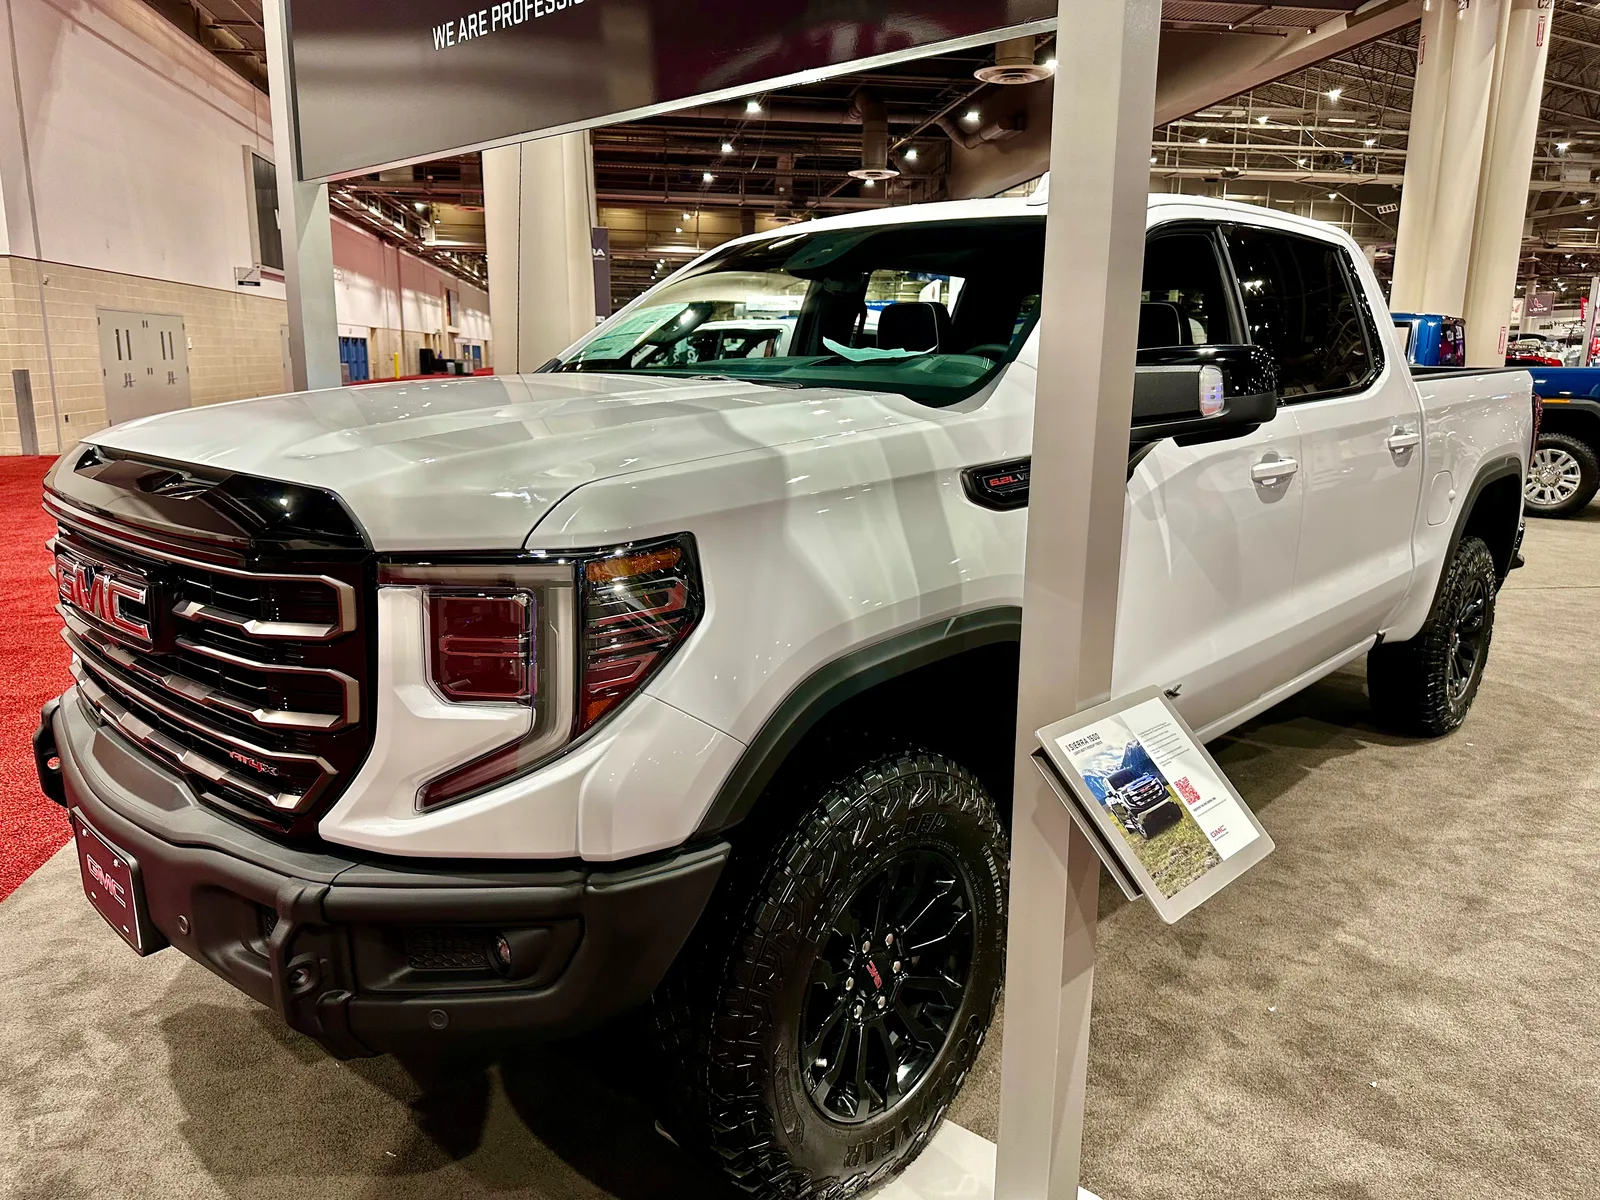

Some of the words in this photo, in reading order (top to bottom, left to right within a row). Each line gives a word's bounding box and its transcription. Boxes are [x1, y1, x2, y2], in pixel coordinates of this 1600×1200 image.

[432, 21, 455, 50] WE
[458, 10, 488, 43] ARE
[492, 0, 585, 32] PROFES
[56, 554, 152, 641] GMC
[1068, 738, 1089, 751] SIERRA
[1210, 825, 1226, 838] GMC
[87, 854, 126, 908] GMC
[866, 960, 883, 989] GMC
